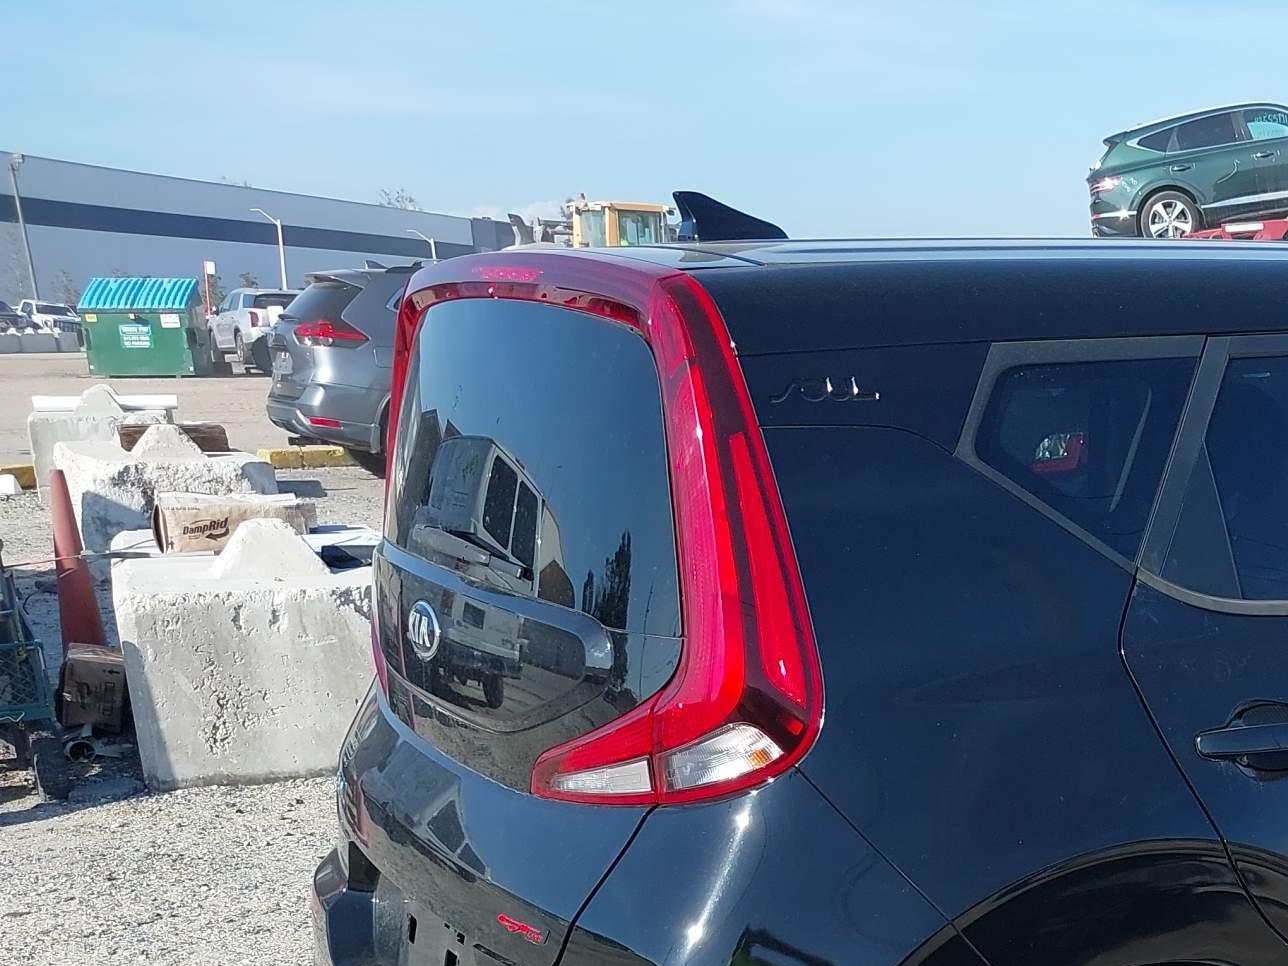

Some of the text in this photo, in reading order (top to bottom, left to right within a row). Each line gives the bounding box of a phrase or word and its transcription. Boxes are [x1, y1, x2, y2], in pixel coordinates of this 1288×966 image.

[769, 376, 880, 403] SOUL
[183, 517, 228, 535] DampRid
[409, 610, 431, 648] KIA
